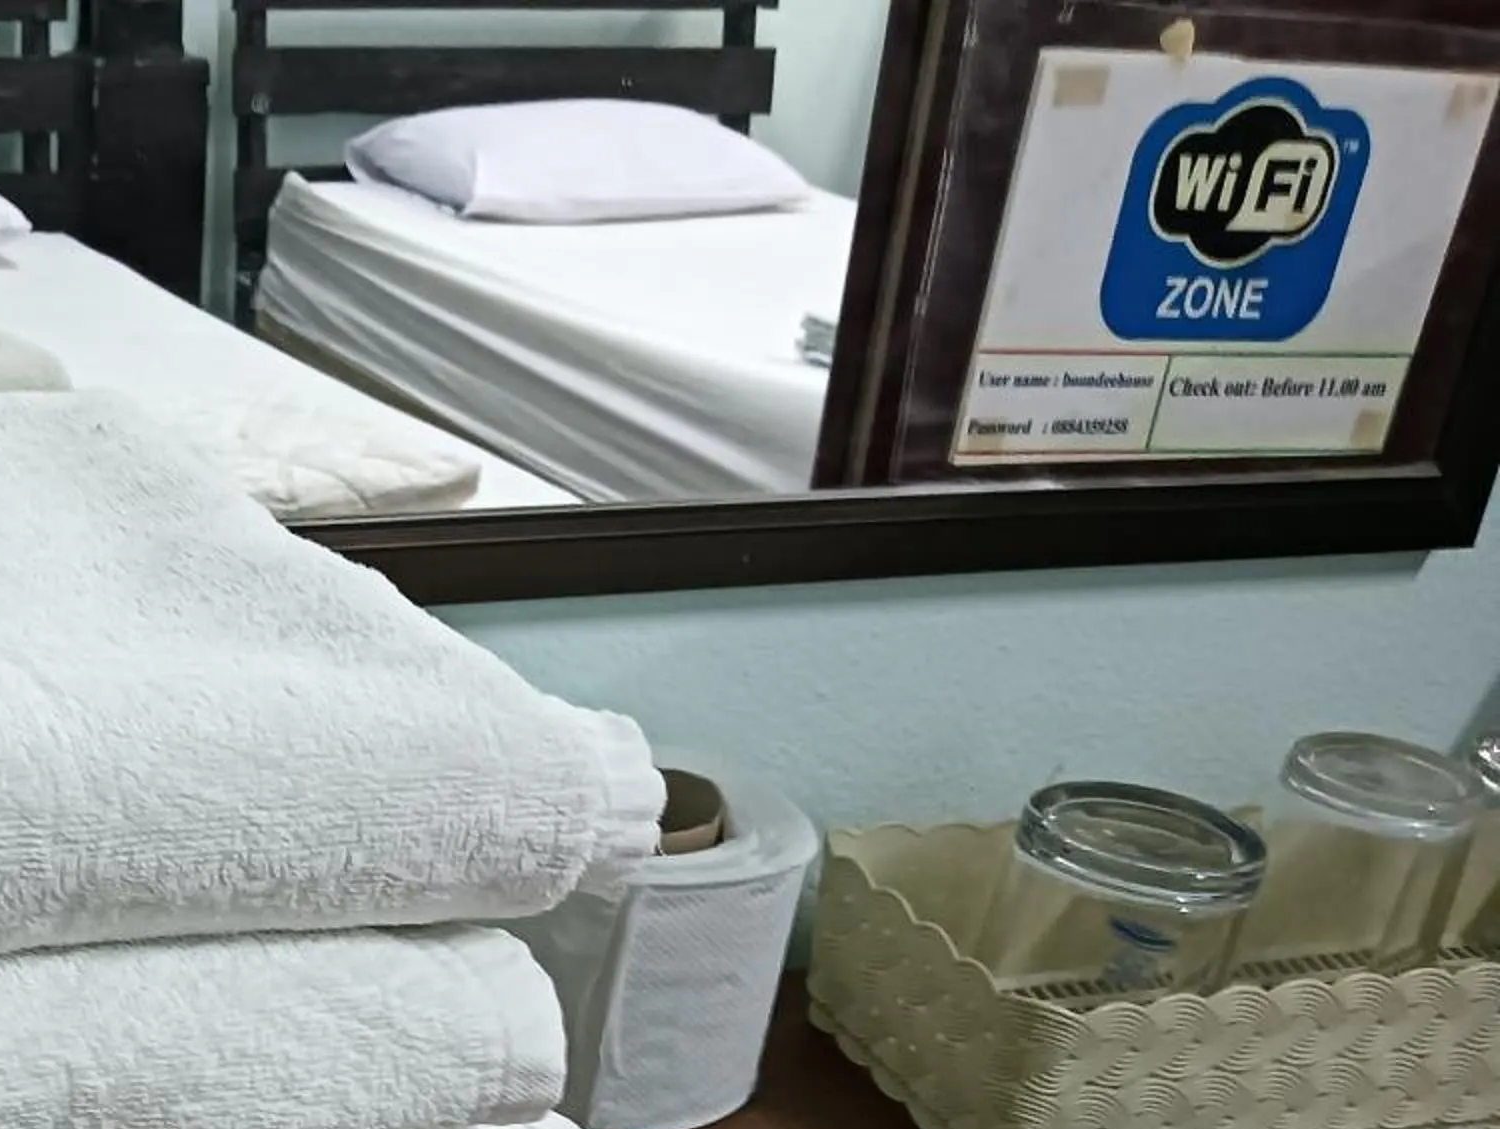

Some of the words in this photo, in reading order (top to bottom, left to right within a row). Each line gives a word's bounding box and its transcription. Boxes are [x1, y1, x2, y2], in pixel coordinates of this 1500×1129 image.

[1155, 275, 1269, 319] ZONE
[979, 371, 1012, 388] User
[1013, 375, 1050, 388] name
[1169, 376, 1220, 398] Check
[1223, 378, 1258, 398] out:
[1261, 376, 1315, 398] Before
[1318, 376, 1360, 398] 11.00
[1361, 382, 1387, 397] am
